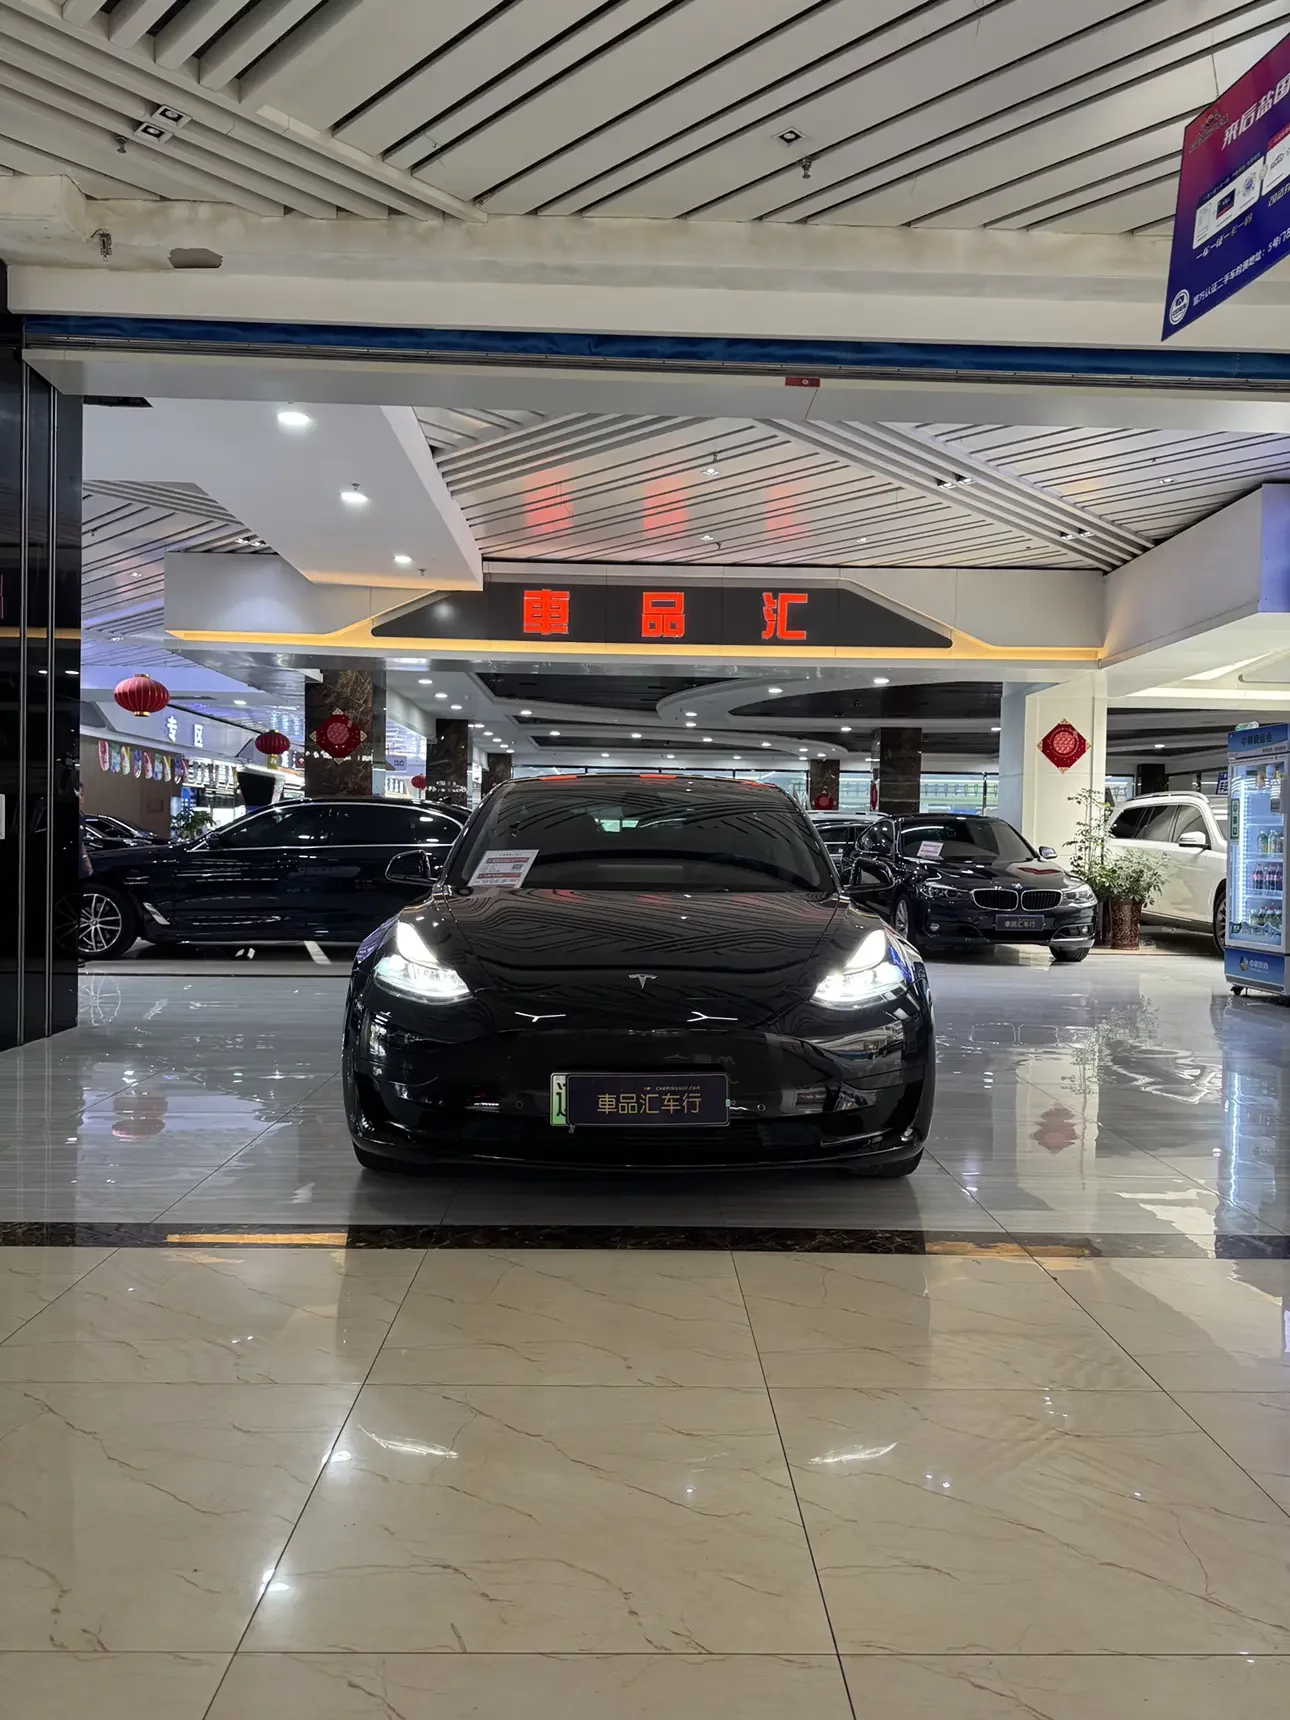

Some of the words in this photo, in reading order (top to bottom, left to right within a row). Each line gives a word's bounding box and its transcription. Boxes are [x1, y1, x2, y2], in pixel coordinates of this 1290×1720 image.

[523, 589, 808, 641] 車品汇
[597, 1092, 702, 1115] 車品汇车行
